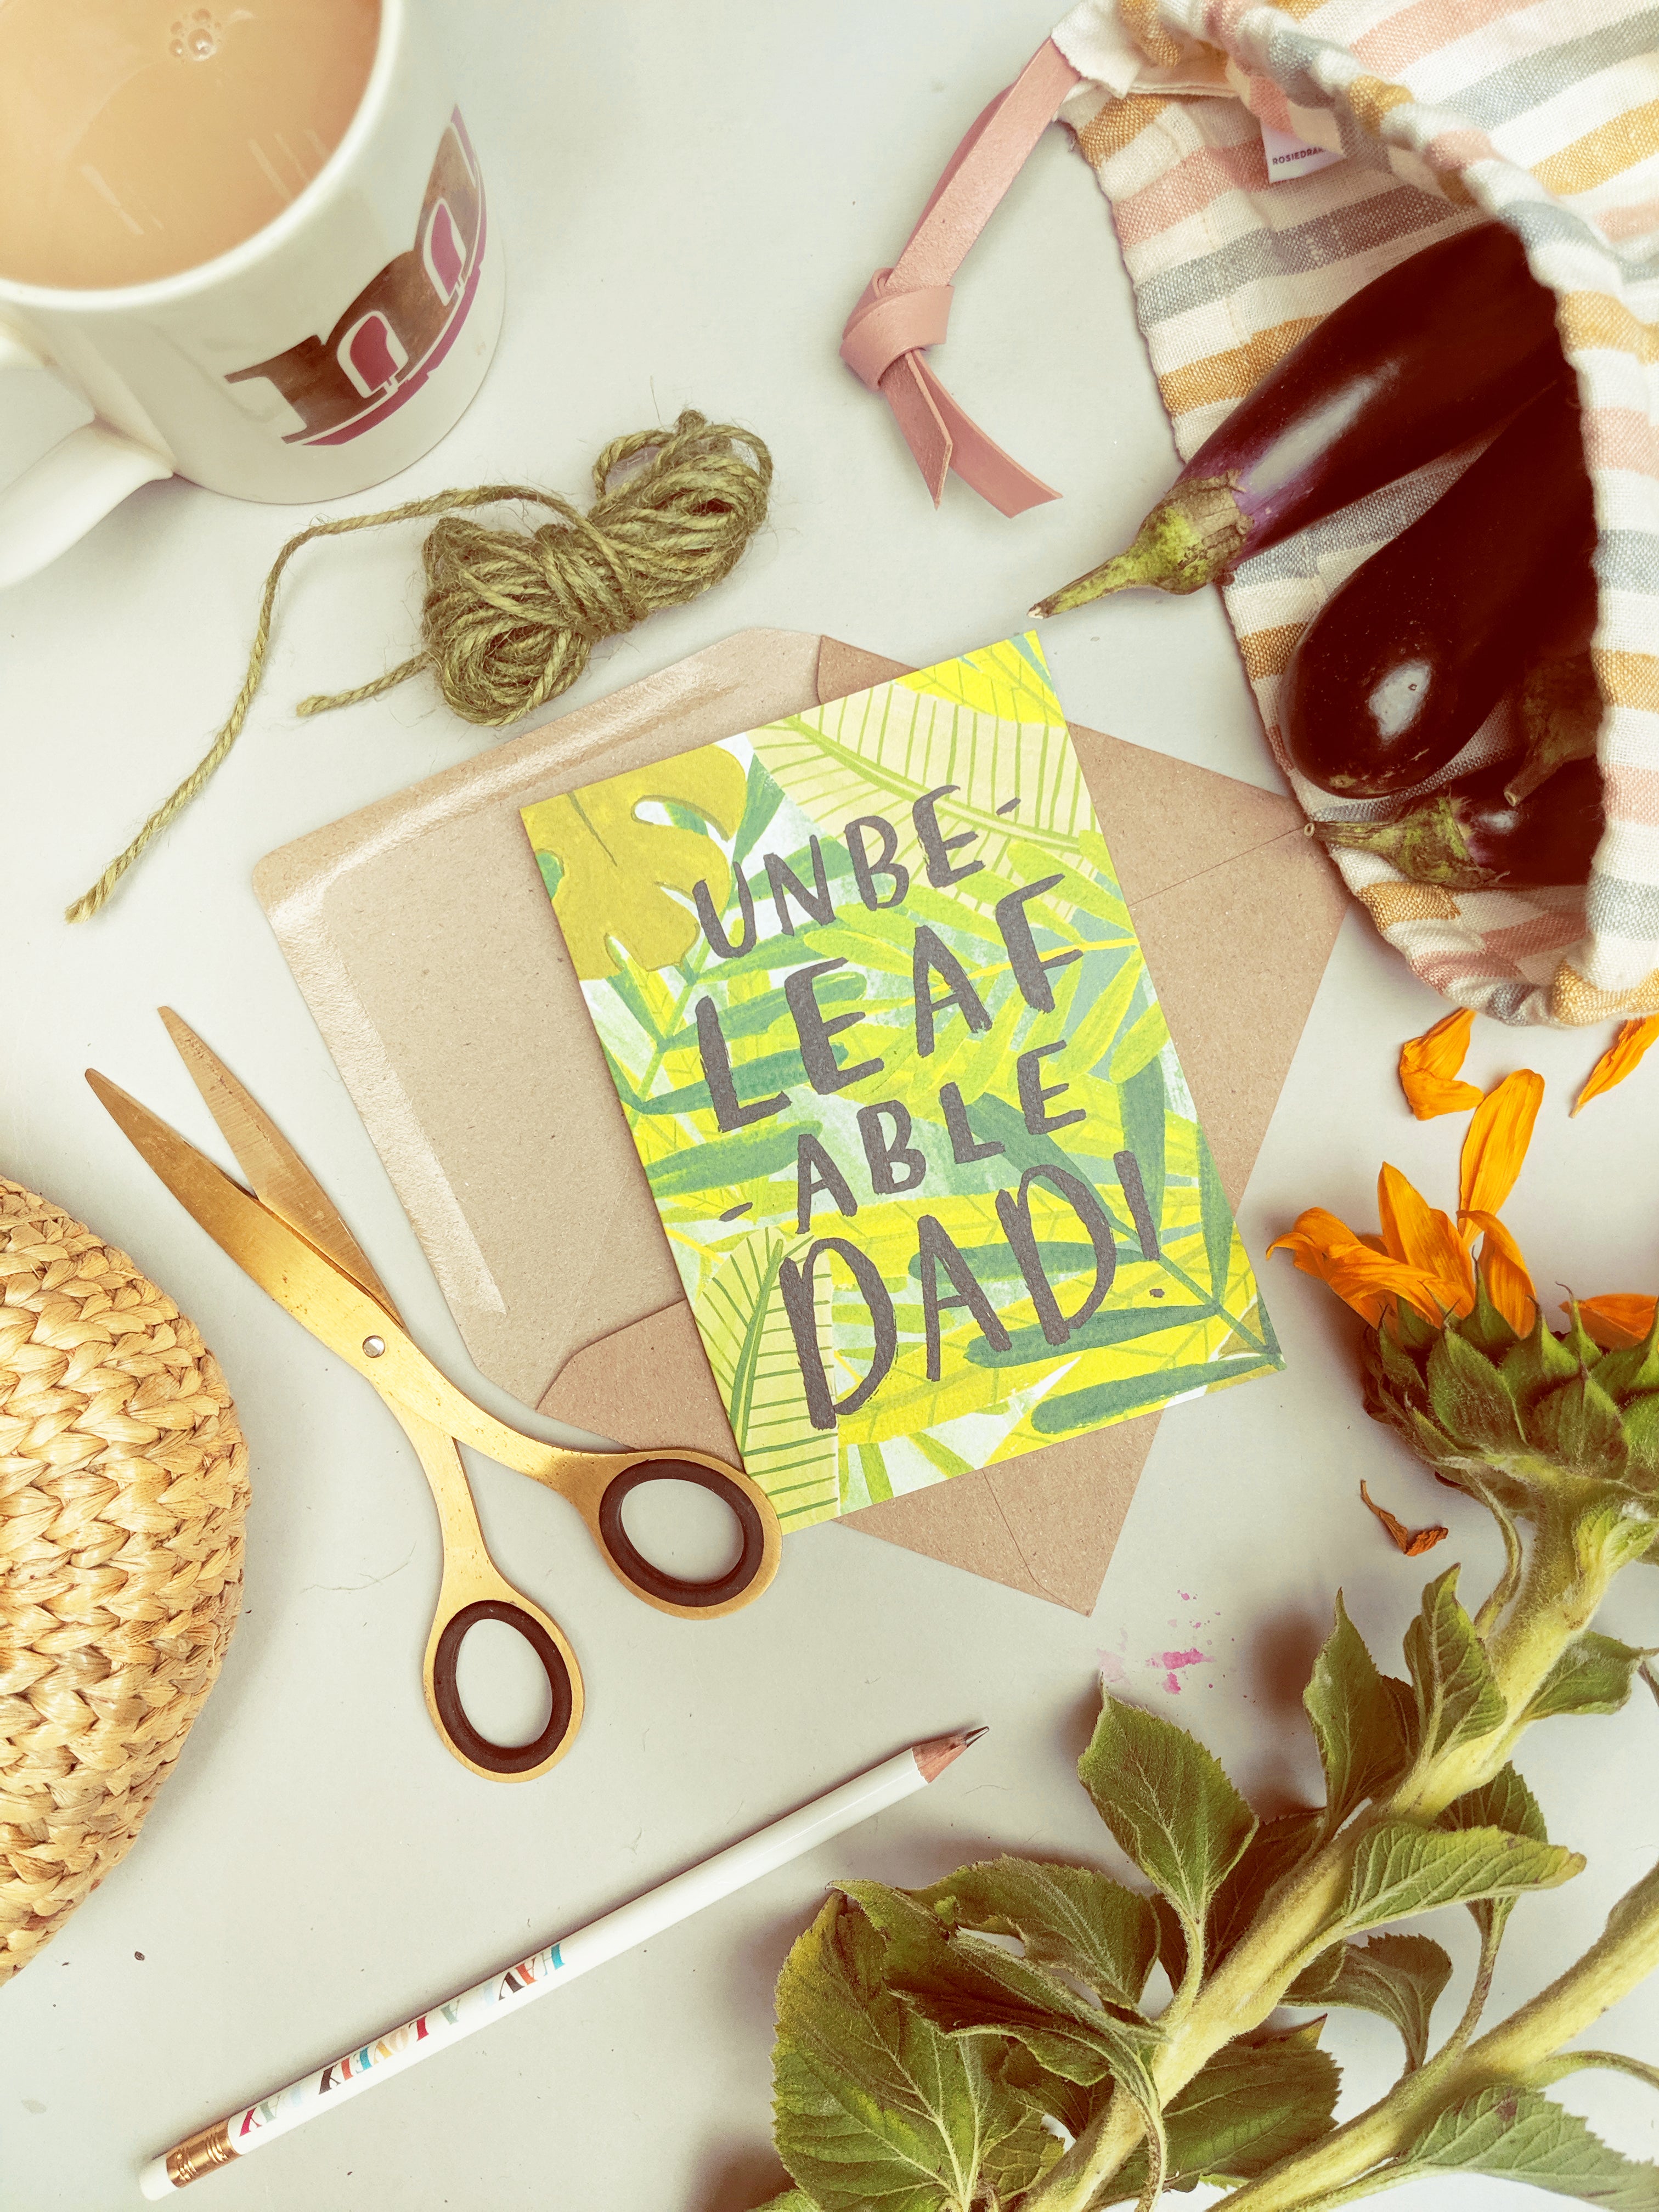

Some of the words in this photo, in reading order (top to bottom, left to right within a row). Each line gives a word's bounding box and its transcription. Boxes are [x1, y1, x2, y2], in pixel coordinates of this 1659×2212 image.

[1272, 146, 1327, 165] ROSIEDRAK
[692, 785, 1021, 958] UNBE-
[696, 873, 1084, 1132] LEAF
[778, 1150, 1164, 1430] DAD!
[481, 1943, 565, 2006] HAVE
[441, 1998, 461, 2026] A
[319, 2015, 430, 2095] LOVELY
[239, 2086, 303, 2137] DAY
